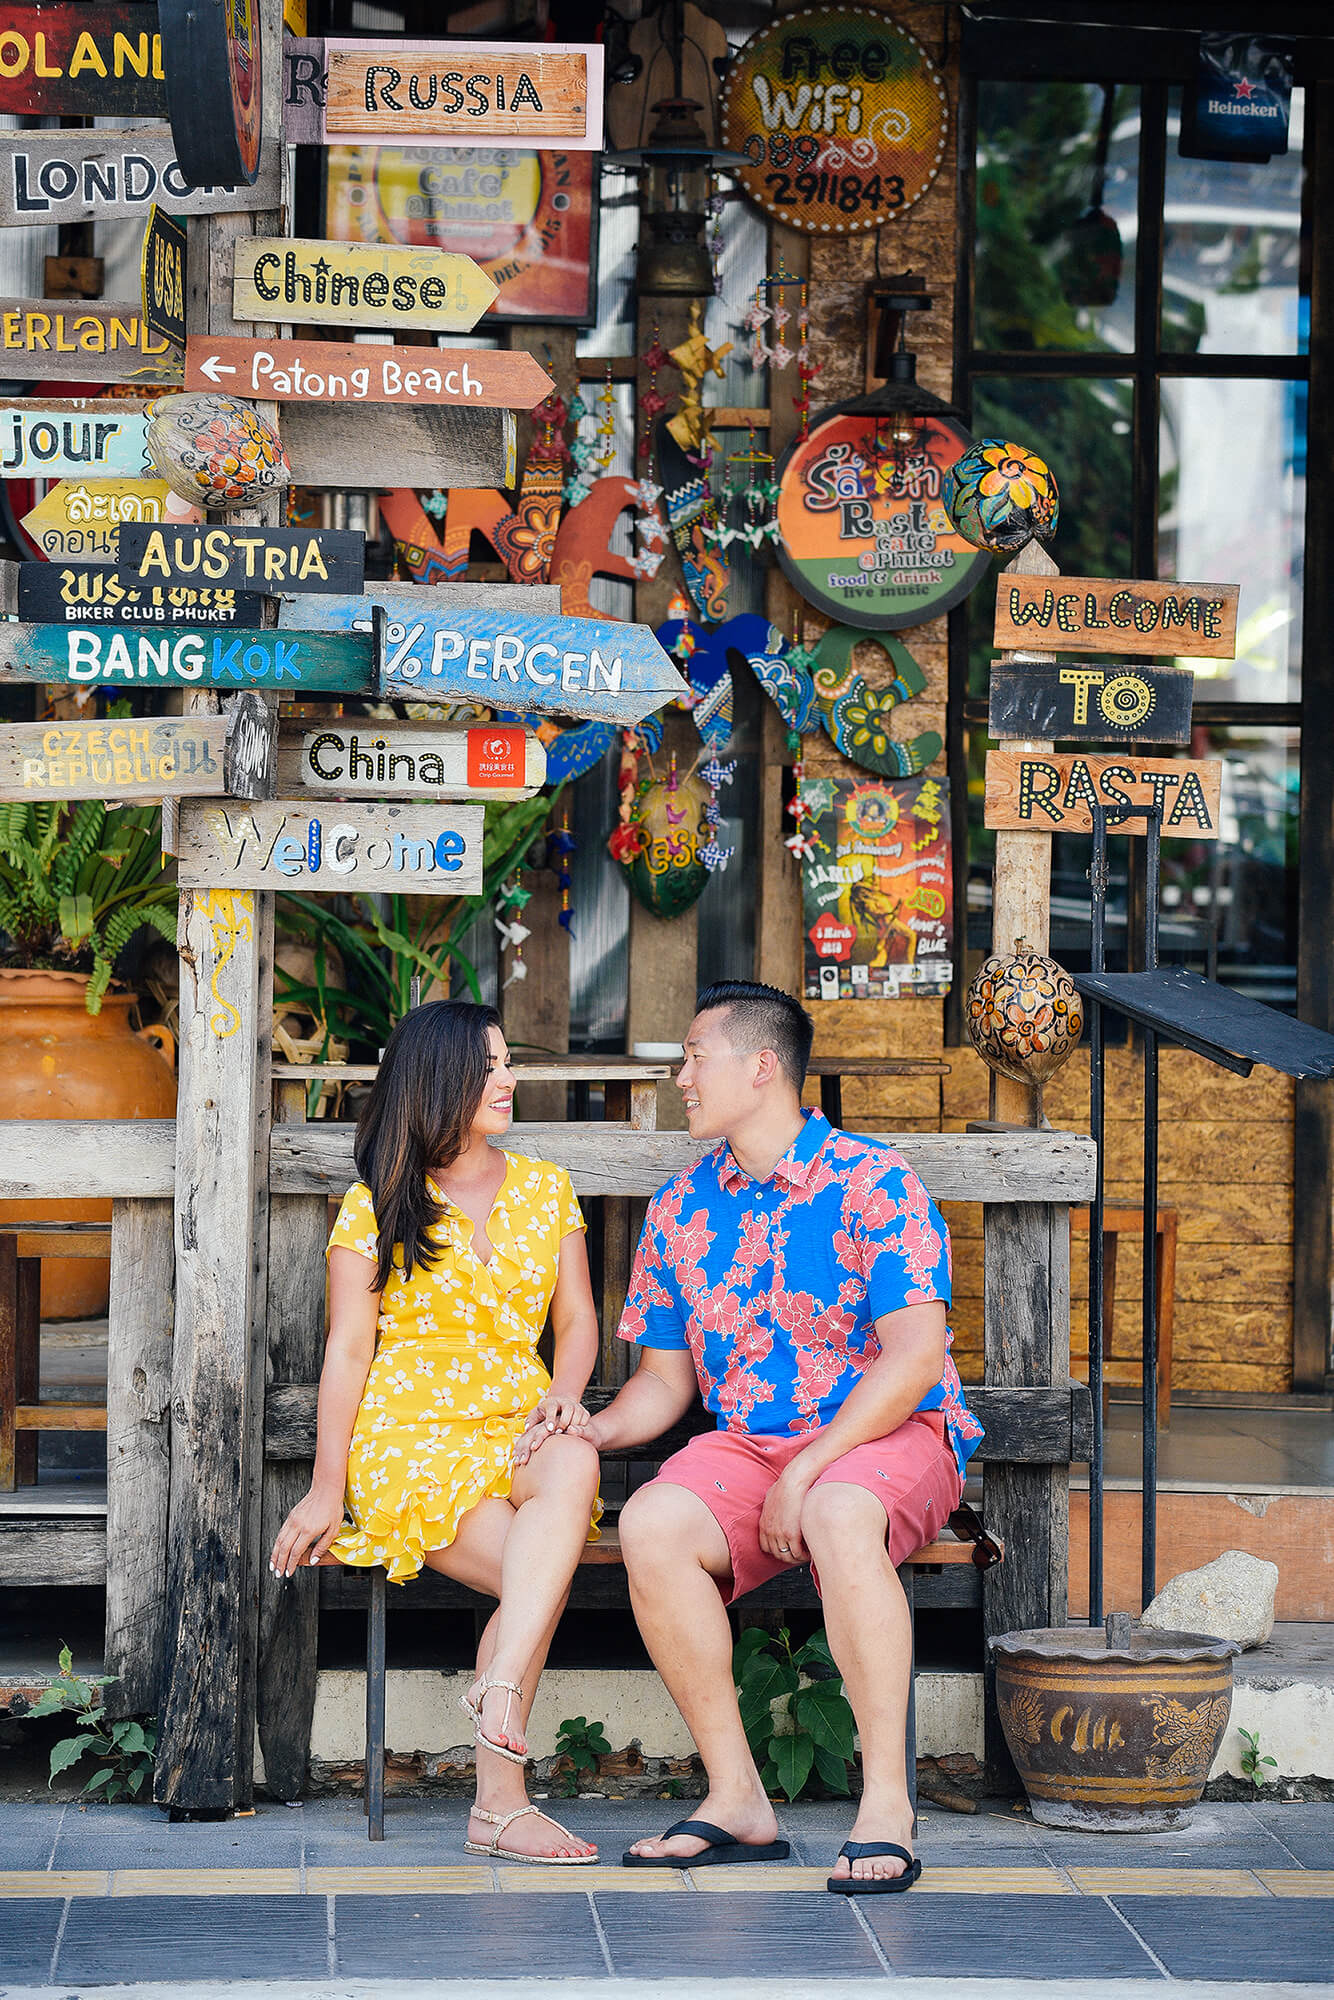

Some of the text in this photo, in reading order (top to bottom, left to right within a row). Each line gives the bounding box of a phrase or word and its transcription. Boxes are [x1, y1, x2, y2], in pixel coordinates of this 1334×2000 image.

[285, 54, 328, 106] R
[781, 37, 888, 82] Free
[366, 66, 543, 116] RUSSIA
[752, 73, 863, 135] WiFi
[1208, 100, 1277, 118] Heineken
[744, 133, 820, 172] 089
[764, 172, 905, 213] 2911843
[154, 233, 184, 321] USA
[253, 251, 446, 311] Chinese
[252, 351, 483, 398] Patong Beach
[3, 415, 121, 470] jour
[840, 500, 956, 539] Rasta
[139, 530, 328, 581] AUSTRIA
[828, 570, 942, 588] food & drink
[65, 606, 237, 621] BIKER CLUB PHUKET
[843, 583, 930, 599] live music
[1010, 587, 1223, 638] WELCOME
[67, 630, 301, 681] BANGKOK
[1059, 669, 1156, 731] TO
[42, 728, 150, 757] CZECH
[309, 733, 444, 785] China
[23, 755, 177, 788] REPUBLIC
[1019, 760, 1213, 829] RASTA
[203, 808, 466, 877] Welcome
[917, 937, 948, 955] BLUE
